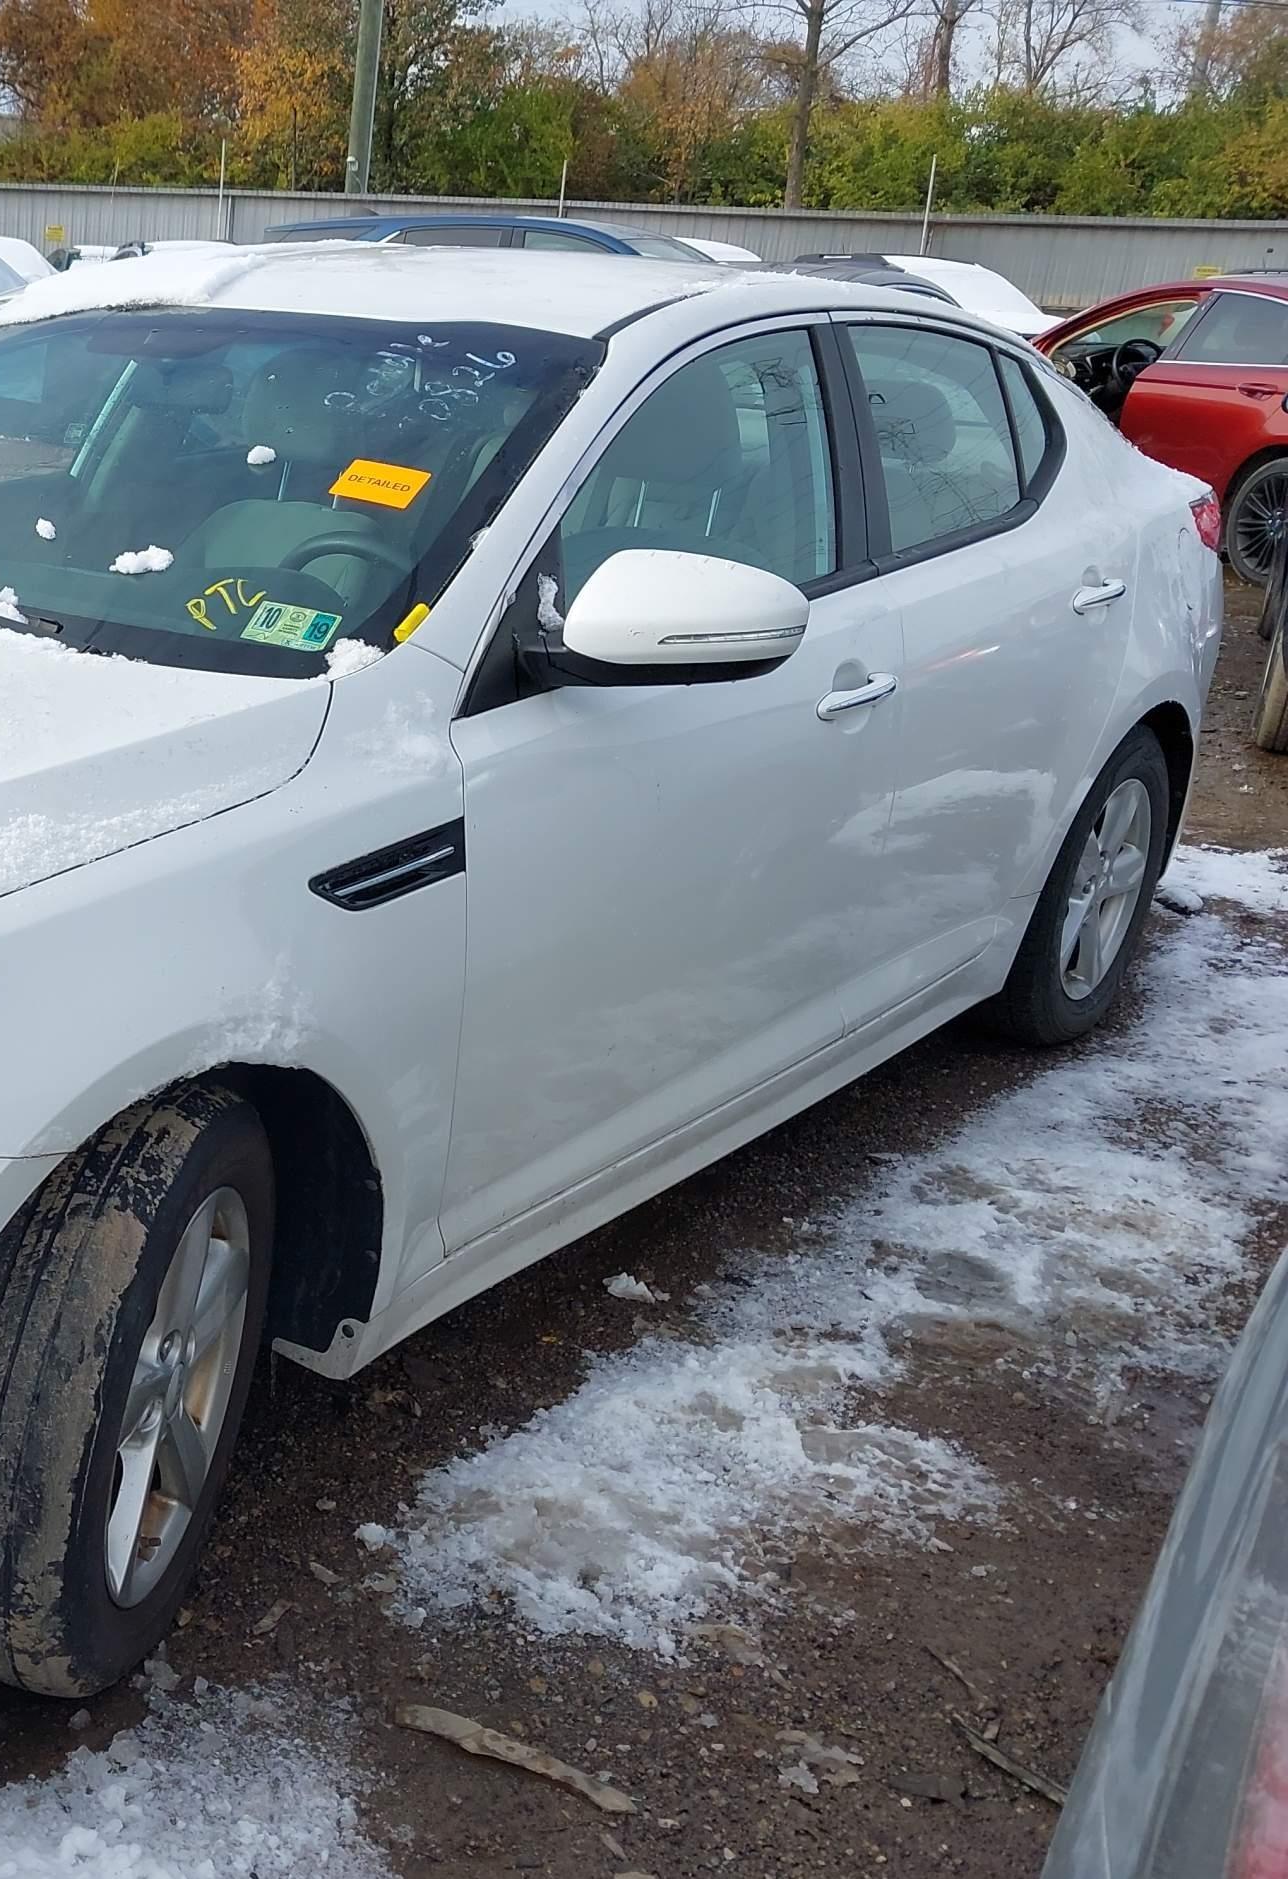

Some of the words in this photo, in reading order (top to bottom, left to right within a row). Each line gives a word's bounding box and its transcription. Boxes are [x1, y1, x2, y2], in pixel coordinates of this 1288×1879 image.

[347, 474, 411, 492] DETAILED
[259, 606, 283, 629] 10
[307, 621, 331, 640] 19
